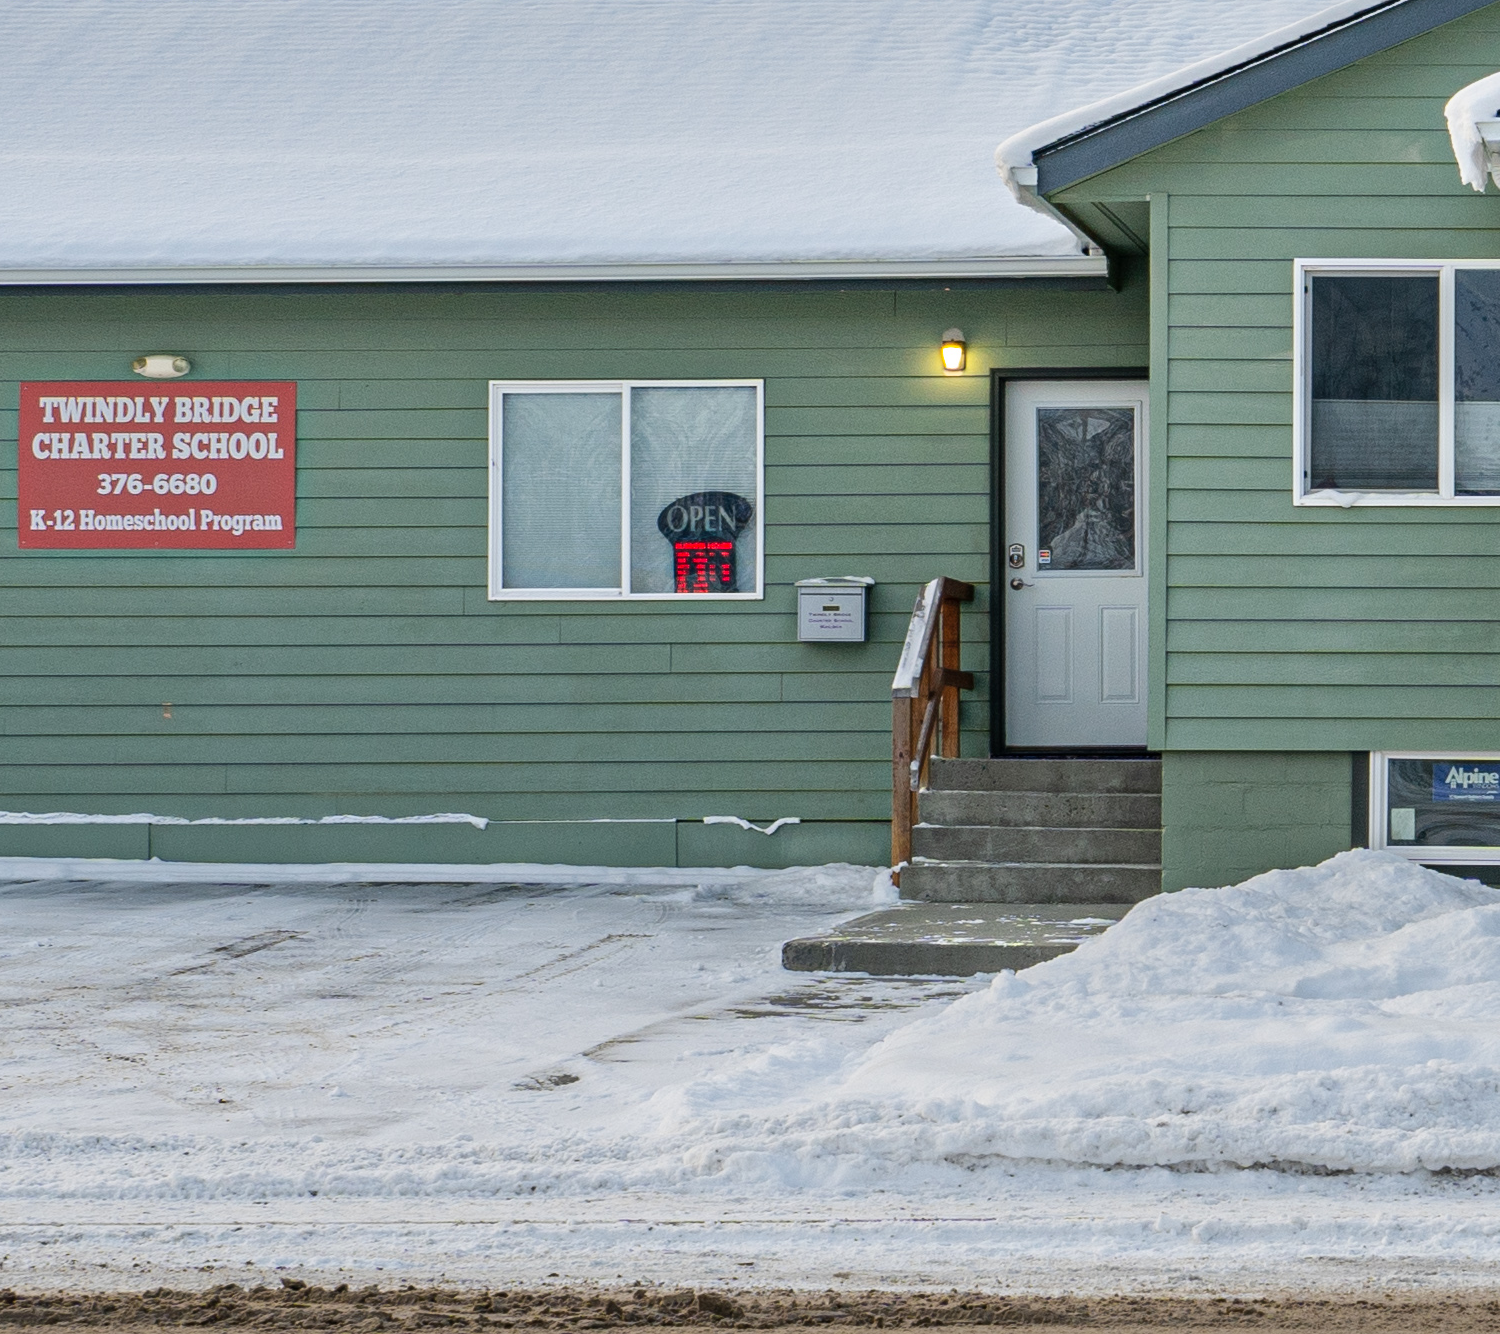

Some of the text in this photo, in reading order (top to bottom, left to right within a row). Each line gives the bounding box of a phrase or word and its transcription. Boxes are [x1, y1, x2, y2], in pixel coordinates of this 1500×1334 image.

[39, 396, 279, 423] TWINDLY BRIDGE
[32, 432, 284, 460] CHARTER SCHOOL
[96, 473, 218, 495] 376-6680
[30, 508, 283, 536] K-12 Homeschool Program
[666, 505, 736, 532] OPEN
[1445, 766, 1499, 789] Alpine
